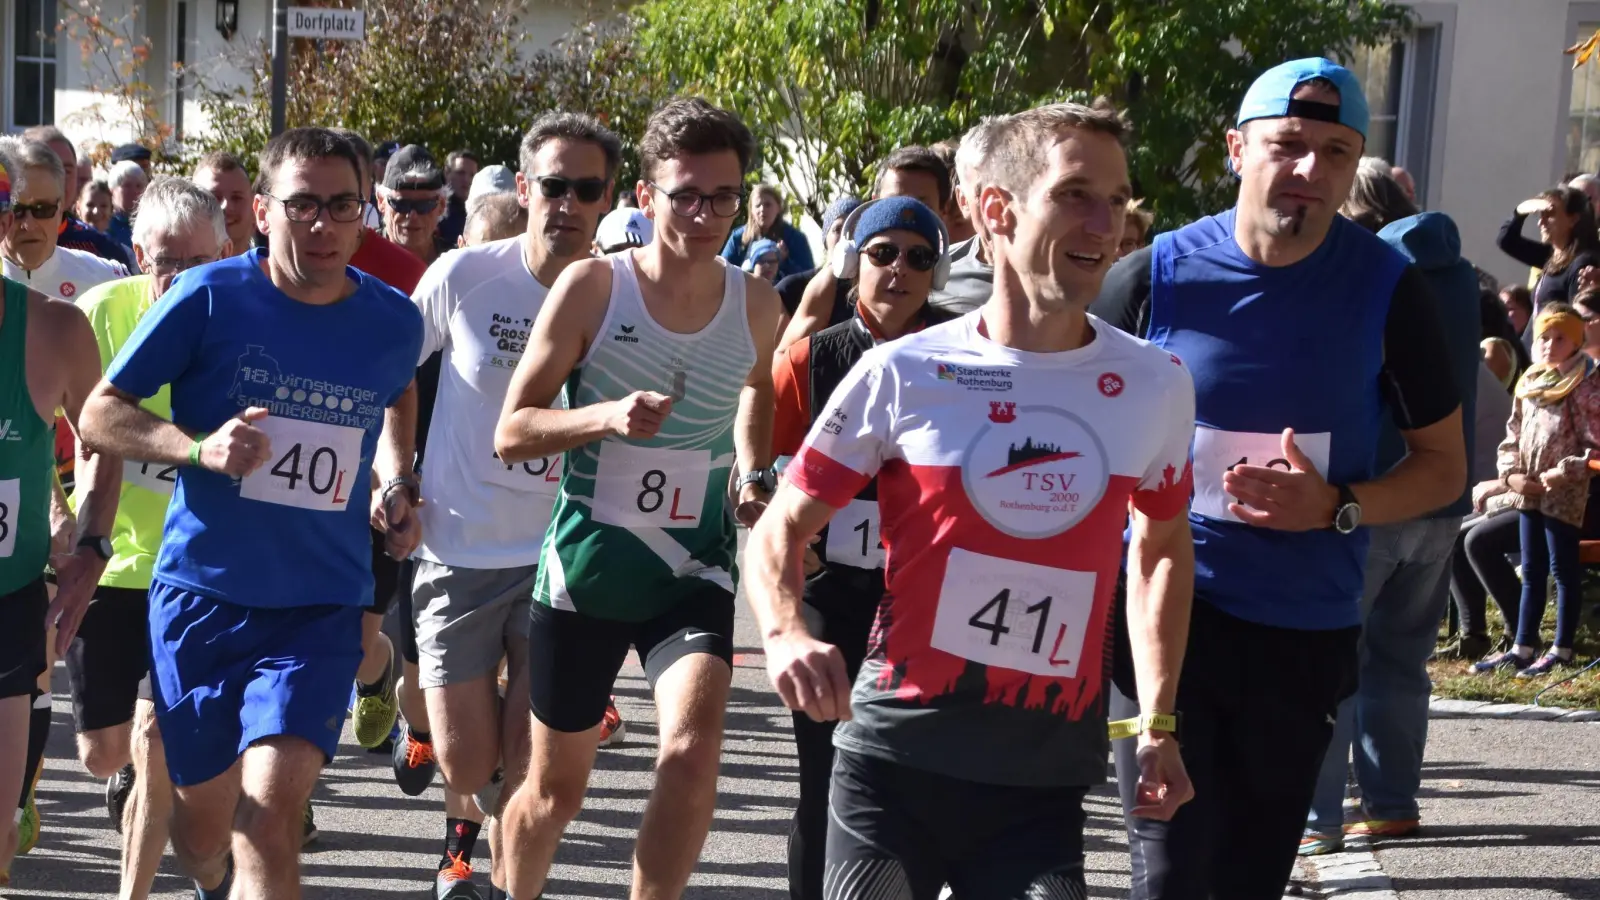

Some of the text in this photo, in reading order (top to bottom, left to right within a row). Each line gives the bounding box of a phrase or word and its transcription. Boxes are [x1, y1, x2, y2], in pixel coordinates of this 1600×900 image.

[295, 12, 356, 36] Dorfplatz
[492, 313, 512, 324] RAD
[614, 334, 639, 343] erima
[956, 366, 1012, 378] Stadtwerke
[956, 376, 1013, 390] Rothenburg
[270, 443, 338, 494] 40
[332, 468, 347, 503] L
[637, 469, 666, 513] 8
[1022, 472, 1077, 492] TSV
[669, 487, 696, 520] L
[1000, 499, 1051, 513] Rothenburg
[1049, 492, 1079, 503] 2000
[854, 518, 886, 557] 1
[968, 588, 1053, 654] 41
[1048, 622, 1070, 666] L
